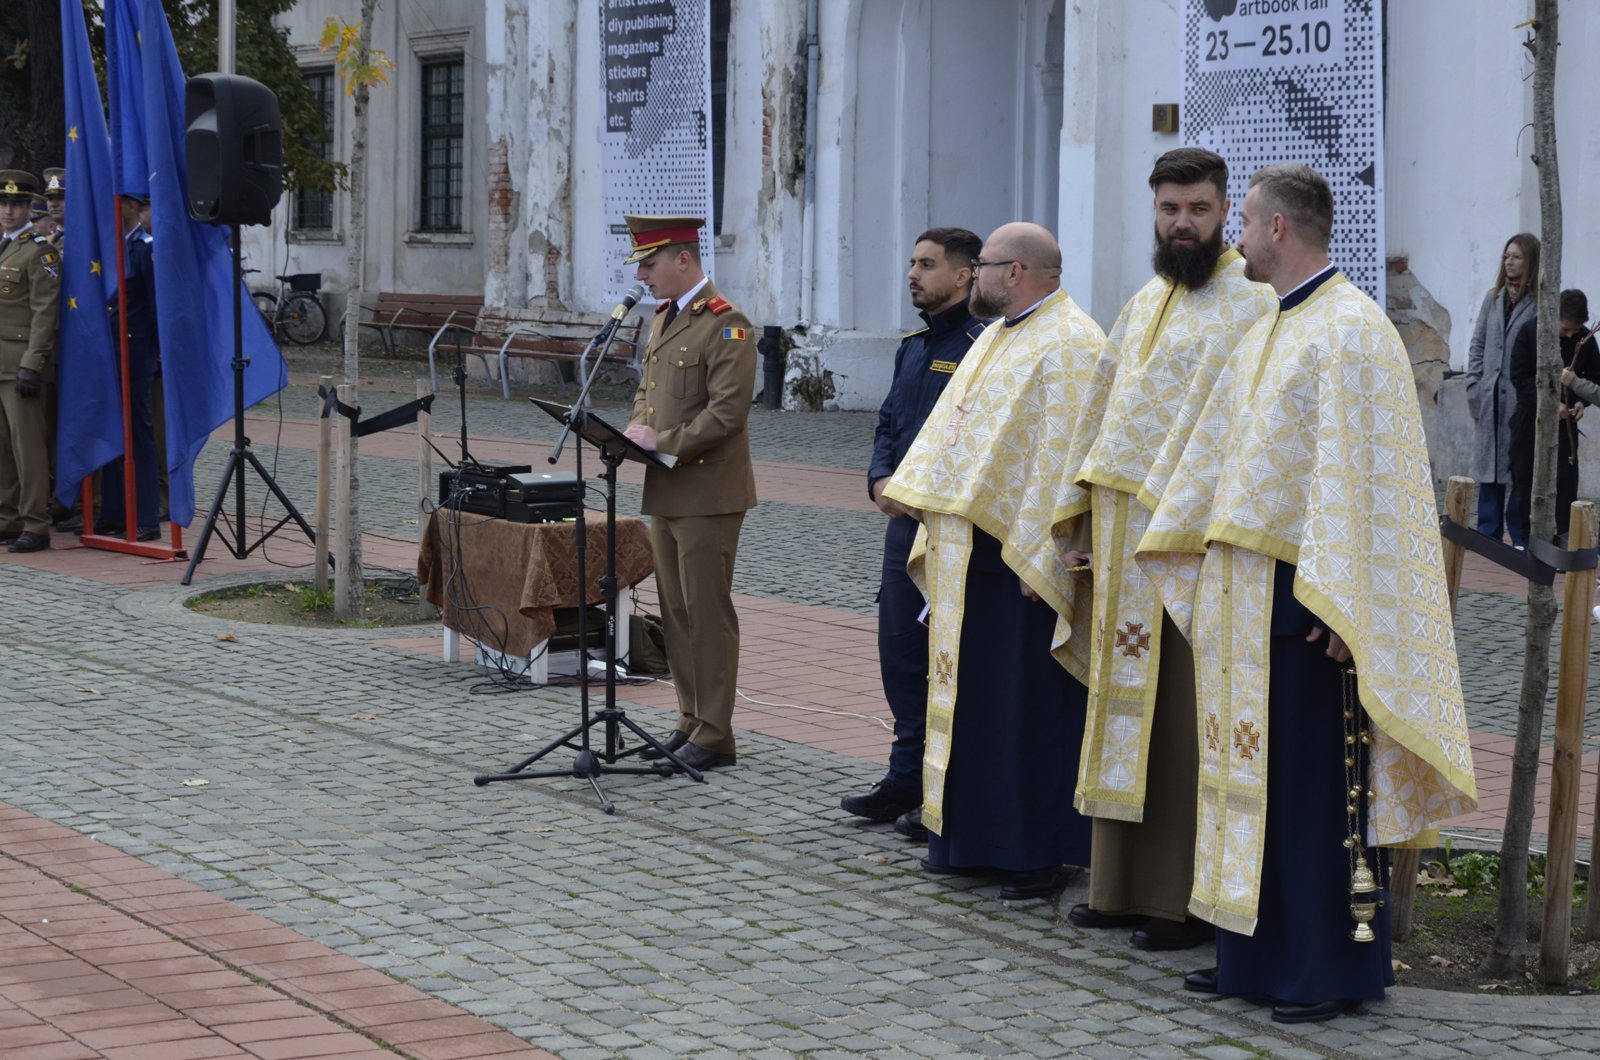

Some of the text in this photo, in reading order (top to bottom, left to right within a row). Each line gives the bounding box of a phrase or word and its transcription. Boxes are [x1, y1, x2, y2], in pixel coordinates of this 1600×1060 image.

[1239, 0, 1300, 16] artbook
[608, 13, 673, 35] diy publishing
[608, 40, 660, 59] magazines
[608, 65, 647, 80] stickers
[608, 88, 645, 103] t-shirts
[609, 113, 627, 127] etc.
